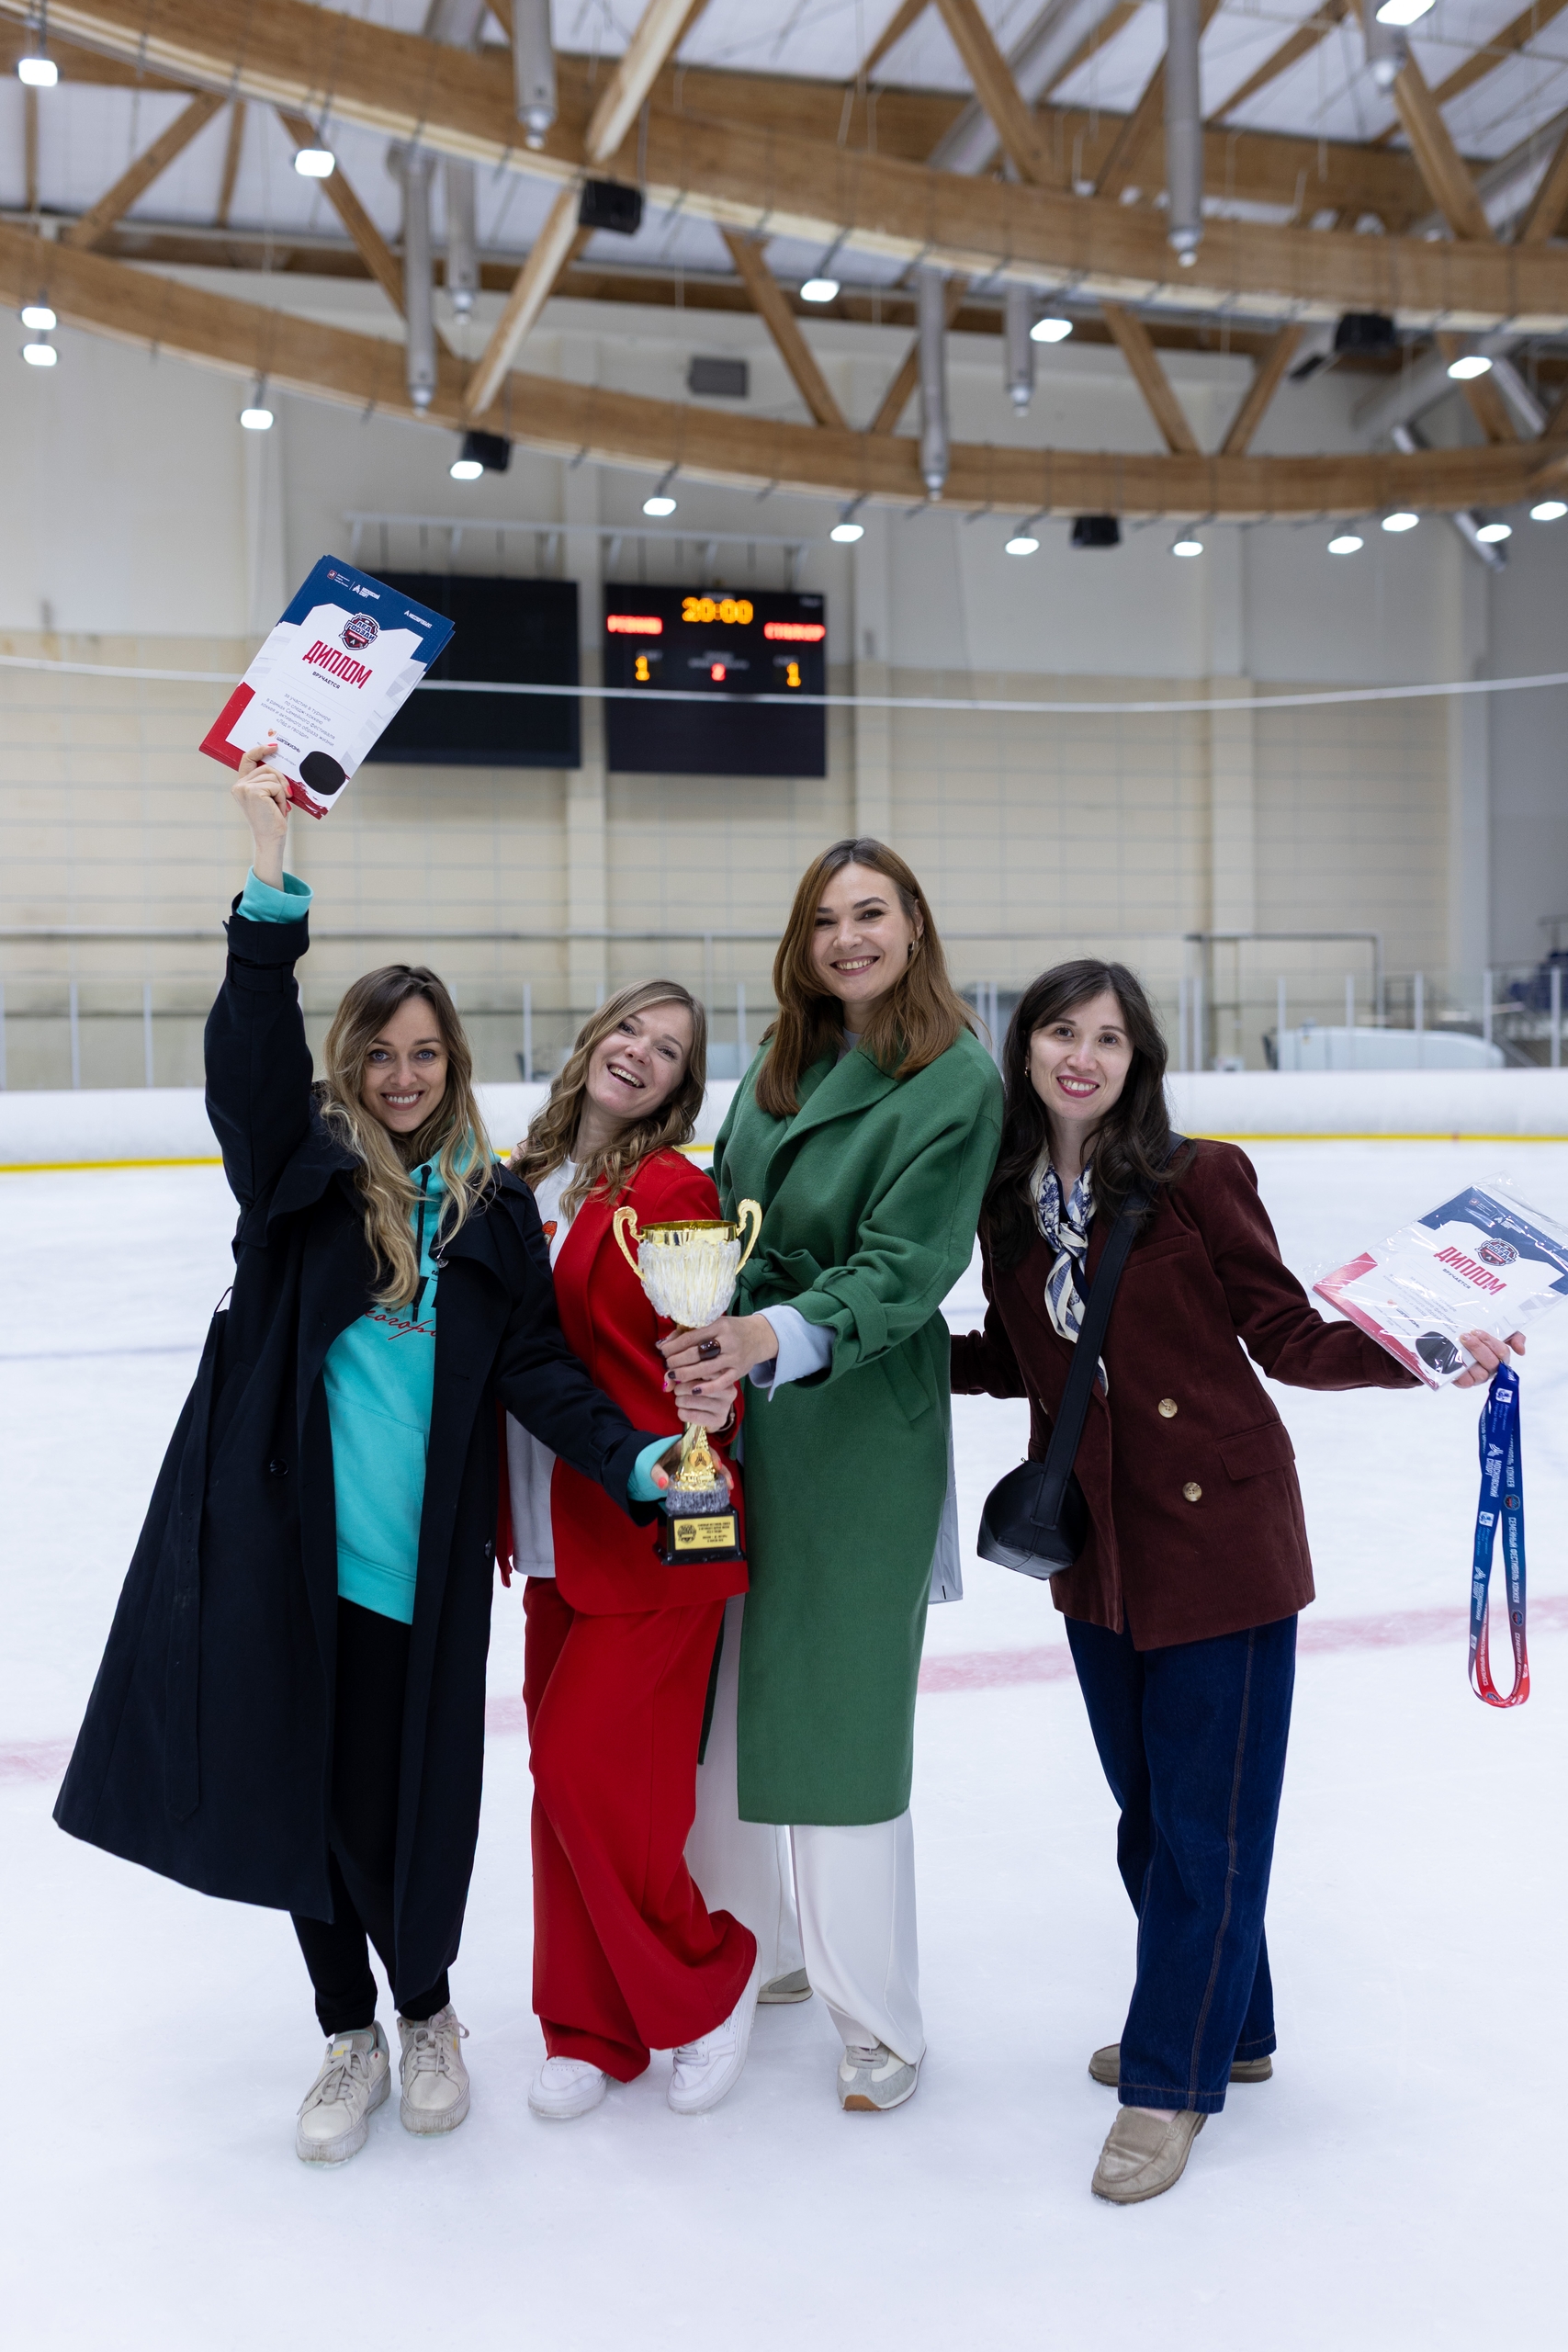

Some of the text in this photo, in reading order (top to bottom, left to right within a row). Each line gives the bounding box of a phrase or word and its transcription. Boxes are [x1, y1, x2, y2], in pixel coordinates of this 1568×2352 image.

[682, 596, 754, 625] 20:00
[302, 638, 373, 692] ДИПЛОМ
[312, 671, 341, 689] ВРУЧАЕТСЯ
[635, 655, 801, 687] 1 1
[269, 700, 286, 712] рамках
[285, 708, 310, 726] Семейного
[310, 723, 336, 741] фестиваля
[289, 696, 308, 710] участие
[311, 708, 332, 723] турнире
[278, 713, 301, 728] активного
[301, 725, 319, 738] образа
[318, 736, 334, 747] жизни
[1433, 1246, 1507, 1295] ДИПЛОМ
[1442, 1268, 1472, 1290] ВРУЧАЕТСЯ
[1484, 1458, 1495, 1476] СПОРТ
[1490, 1459, 1502, 1498] МОСКОВСКИЙ
[1506, 1465, 1515, 1488] ХОККЕЯ
[1507, 1517, 1521, 1603] СЕМЕЙНЫЙ ФЕСТИВАЛЬ ХОККЕЯ
[1475, 1583, 1484, 1622] МОСКОВСКИЙ
